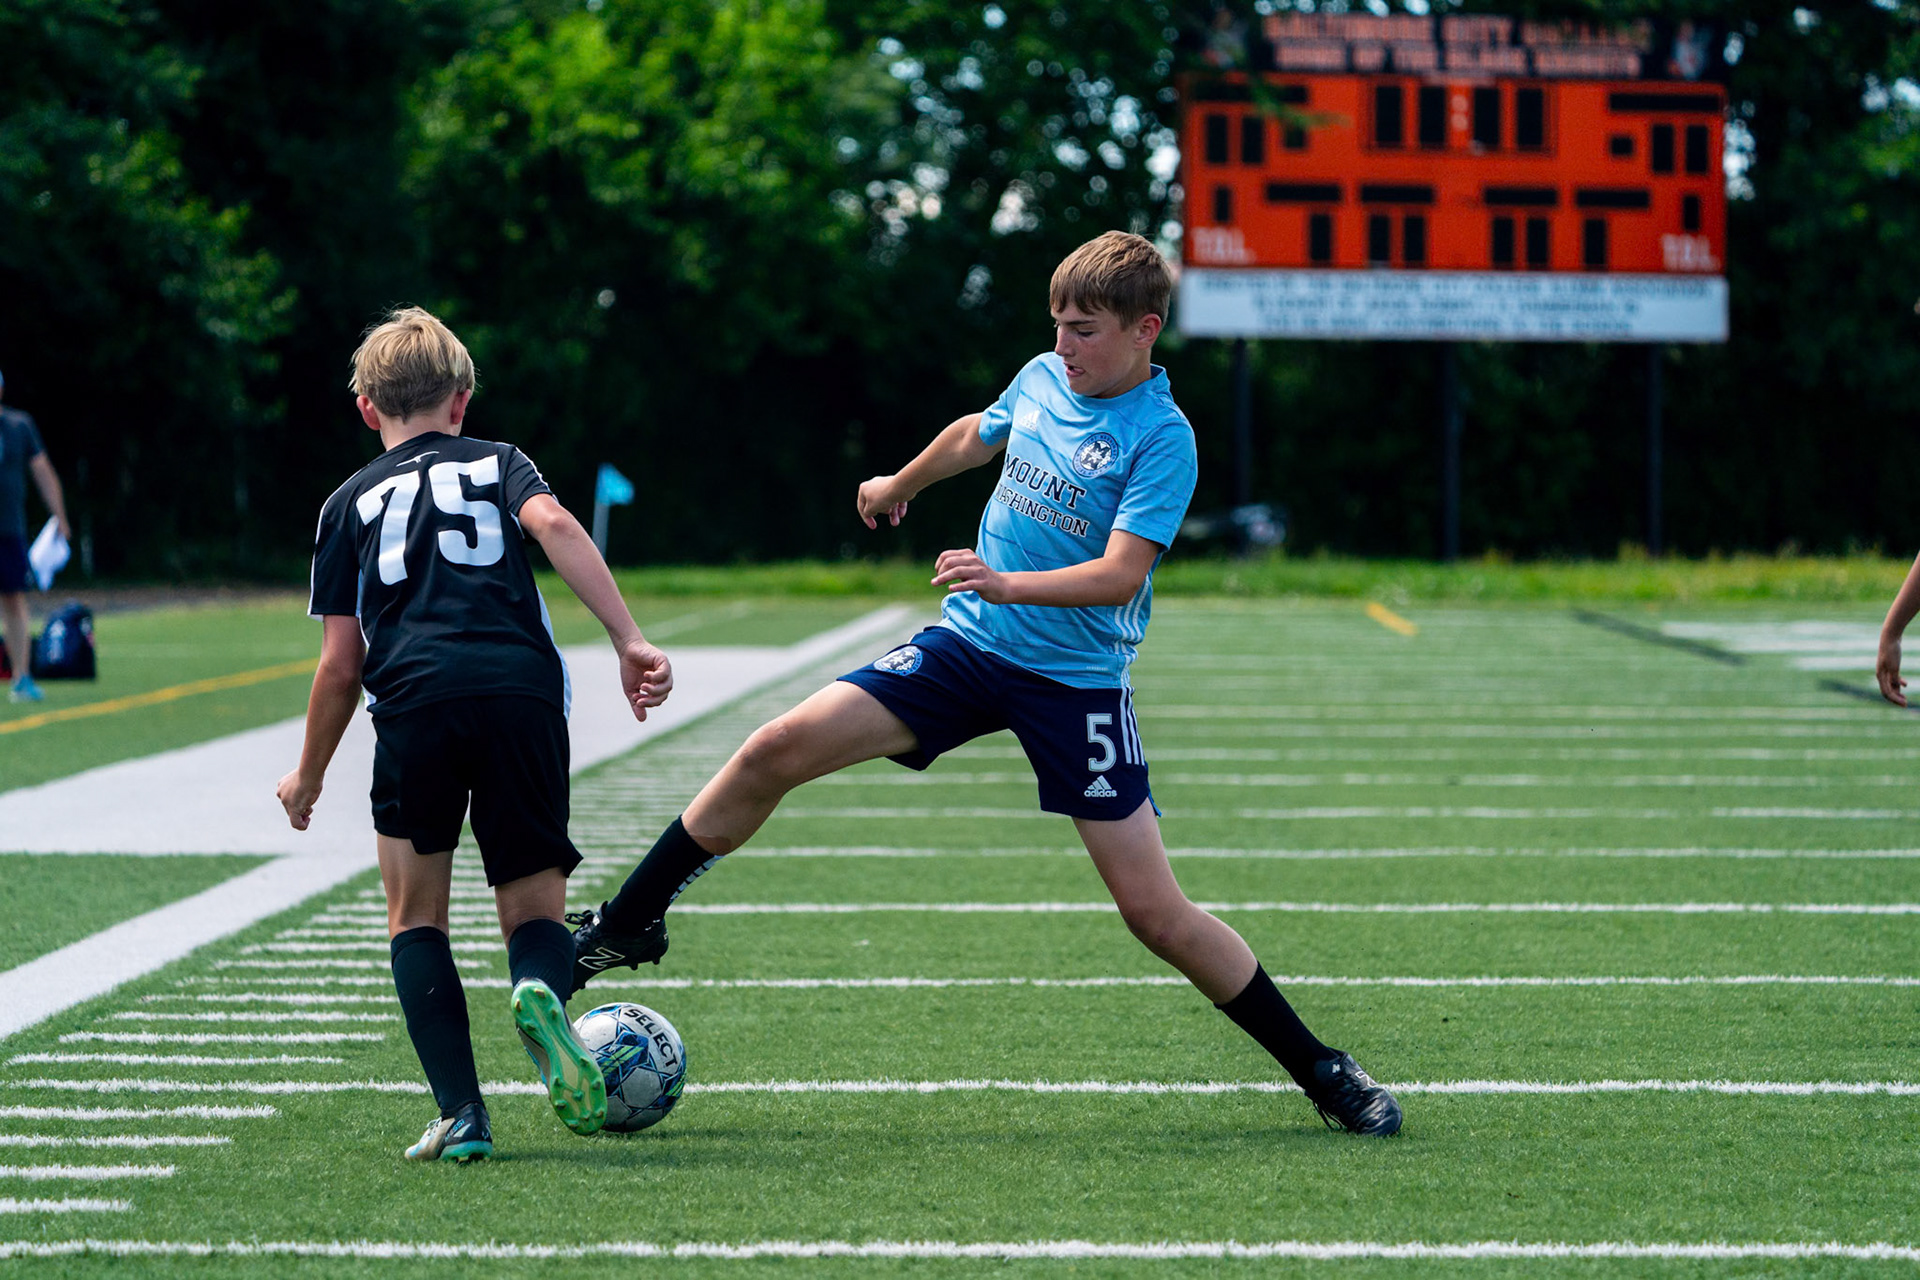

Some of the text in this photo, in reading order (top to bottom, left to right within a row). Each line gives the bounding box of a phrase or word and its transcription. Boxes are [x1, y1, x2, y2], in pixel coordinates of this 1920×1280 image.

[1005, 453, 1087, 509] MOUNT
[356, 454, 505, 586] 75
[1086, 713, 1117, 772] 5
[1084, 789, 1117, 797] adidas
[624, 1008, 678, 1067] SELECT
